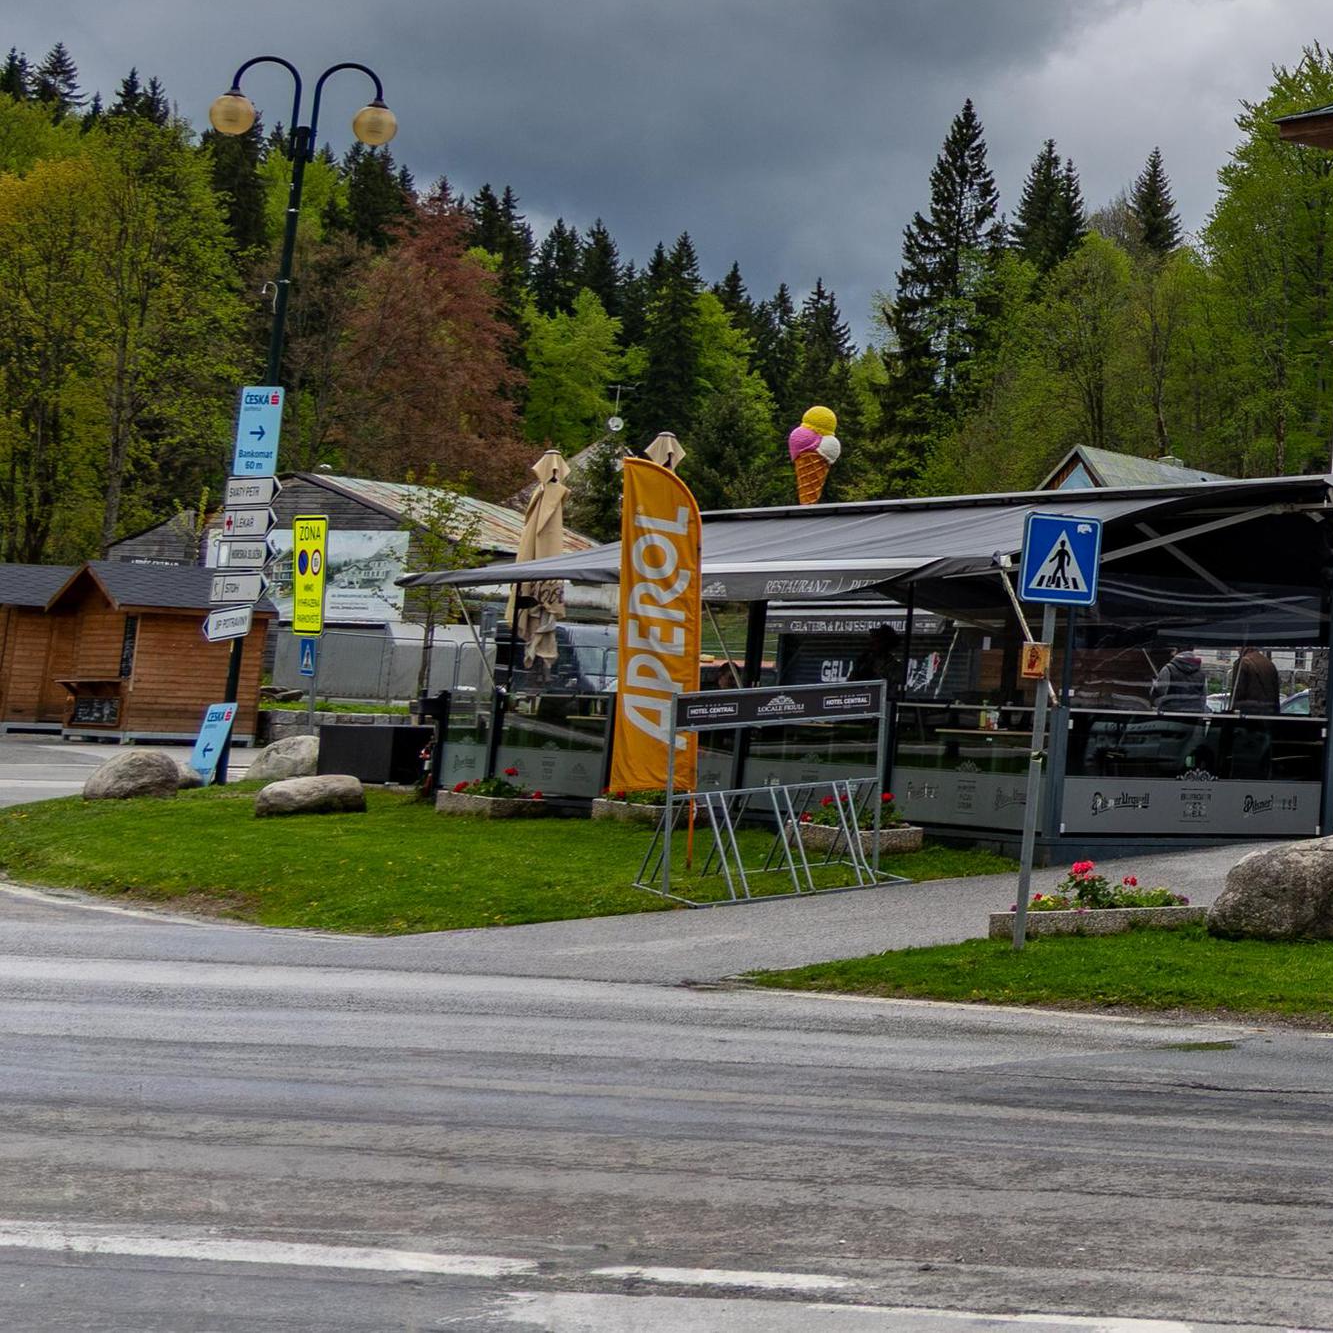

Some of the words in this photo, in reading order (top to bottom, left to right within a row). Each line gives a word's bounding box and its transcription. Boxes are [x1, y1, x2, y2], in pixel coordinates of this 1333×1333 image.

[244, 392, 269, 405] ČESKÁ
[238, 449, 273, 459] Bankomat
[245, 460, 255, 469] 60
[299, 523, 321, 541] ZÓNA
[764, 579, 832, 594] RESTAURANT
[623, 506, 691, 750] APEROL
[826, 698, 842, 706] HOTEL
[843, 696, 868, 705] CENTRAL
[690, 707, 708, 715] HOTEL
[709, 705, 736, 714] CENTRAL
[757, 704, 782, 713] LOCALE
